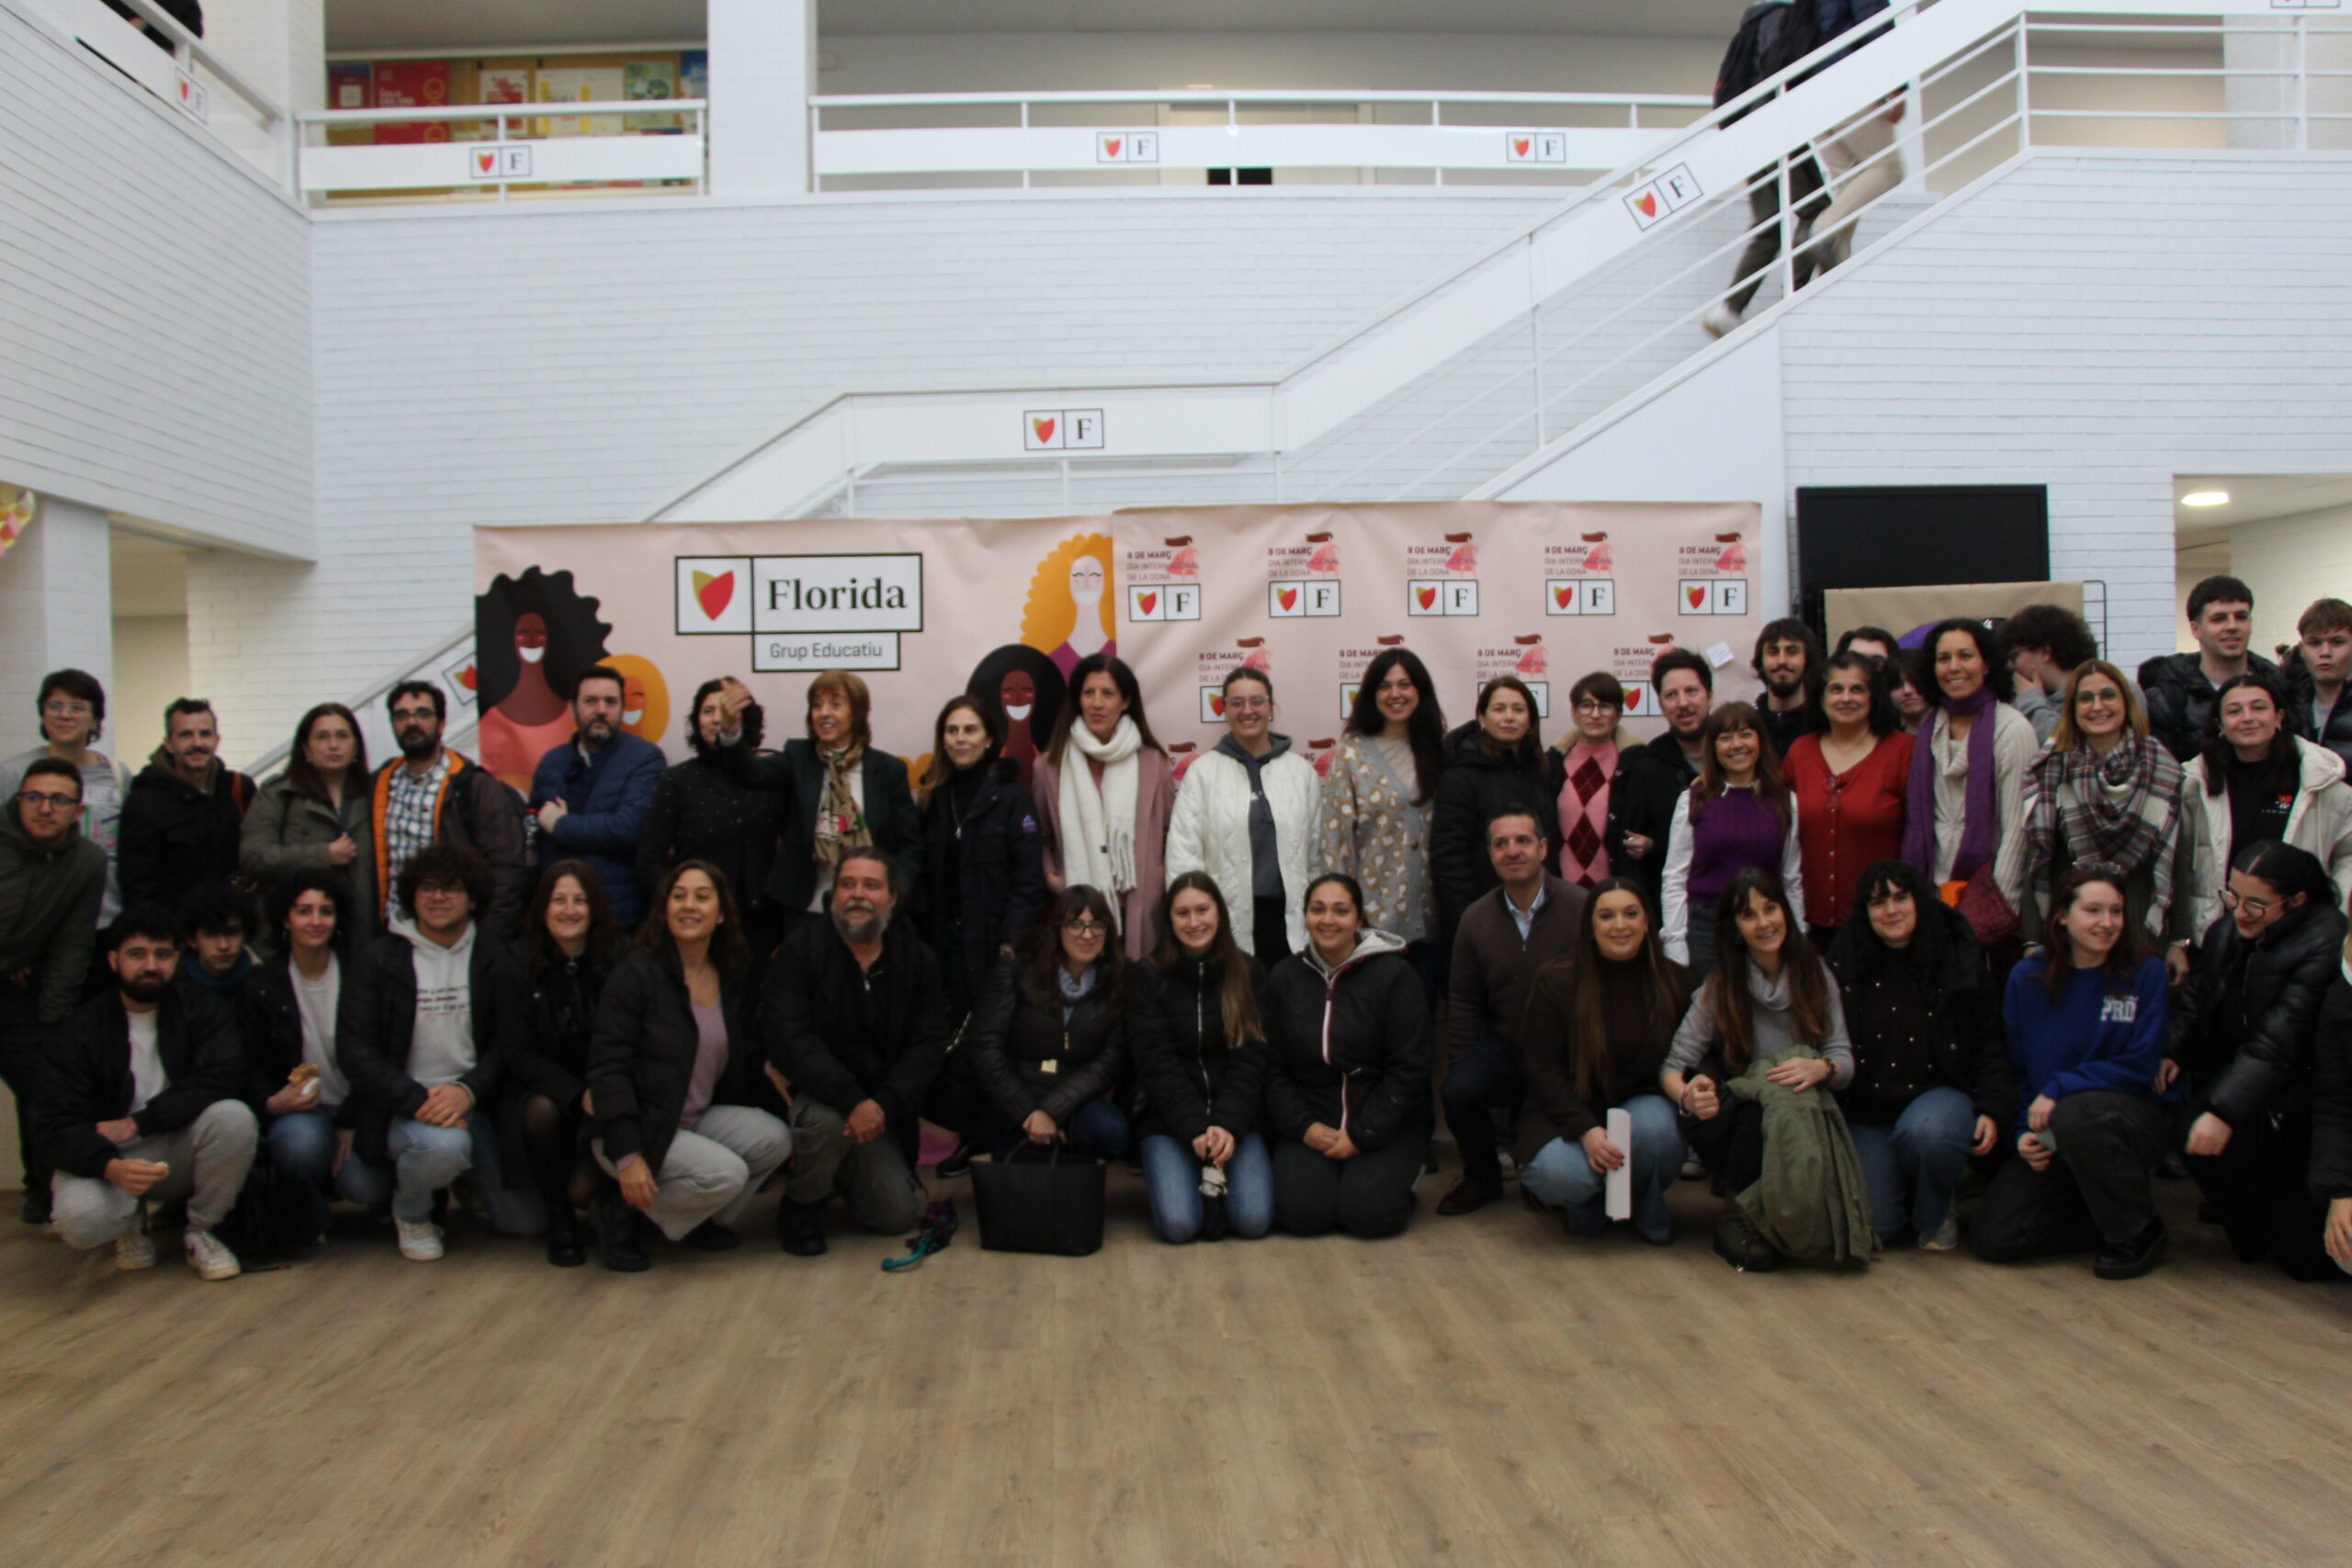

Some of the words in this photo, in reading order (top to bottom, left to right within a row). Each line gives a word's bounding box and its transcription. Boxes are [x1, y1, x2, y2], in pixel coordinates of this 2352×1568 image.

[1136, 139, 1149, 155] F
[1545, 139, 1557, 155] F
[510, 152, 523, 170] F
[1668, 175, 1683, 198] F
[1077, 418, 1091, 440] F
[1147, 550, 1171, 560] MARÇ
[1288, 547, 1312, 556] MARÇ
[1427, 547, 1451, 556] MARÇ
[1564, 546, 1588, 556] MARÇ
[1698, 546, 1721, 556] MARÇ
[767, 577, 907, 611] Florida
[1176, 592, 1190, 612] F
[1317, 588, 1329, 608] F
[1454, 588, 1467, 607] F
[1591, 587, 1604, 607] F
[1724, 587, 1737, 607] F
[770, 642, 808, 660] Grup
[812, 641, 882, 658] Educatiu
[1219, 652, 1244, 661] MARÇ
[1497, 649, 1521, 659] MARÇ
[1633, 648, 1655, 656] MARÇ
